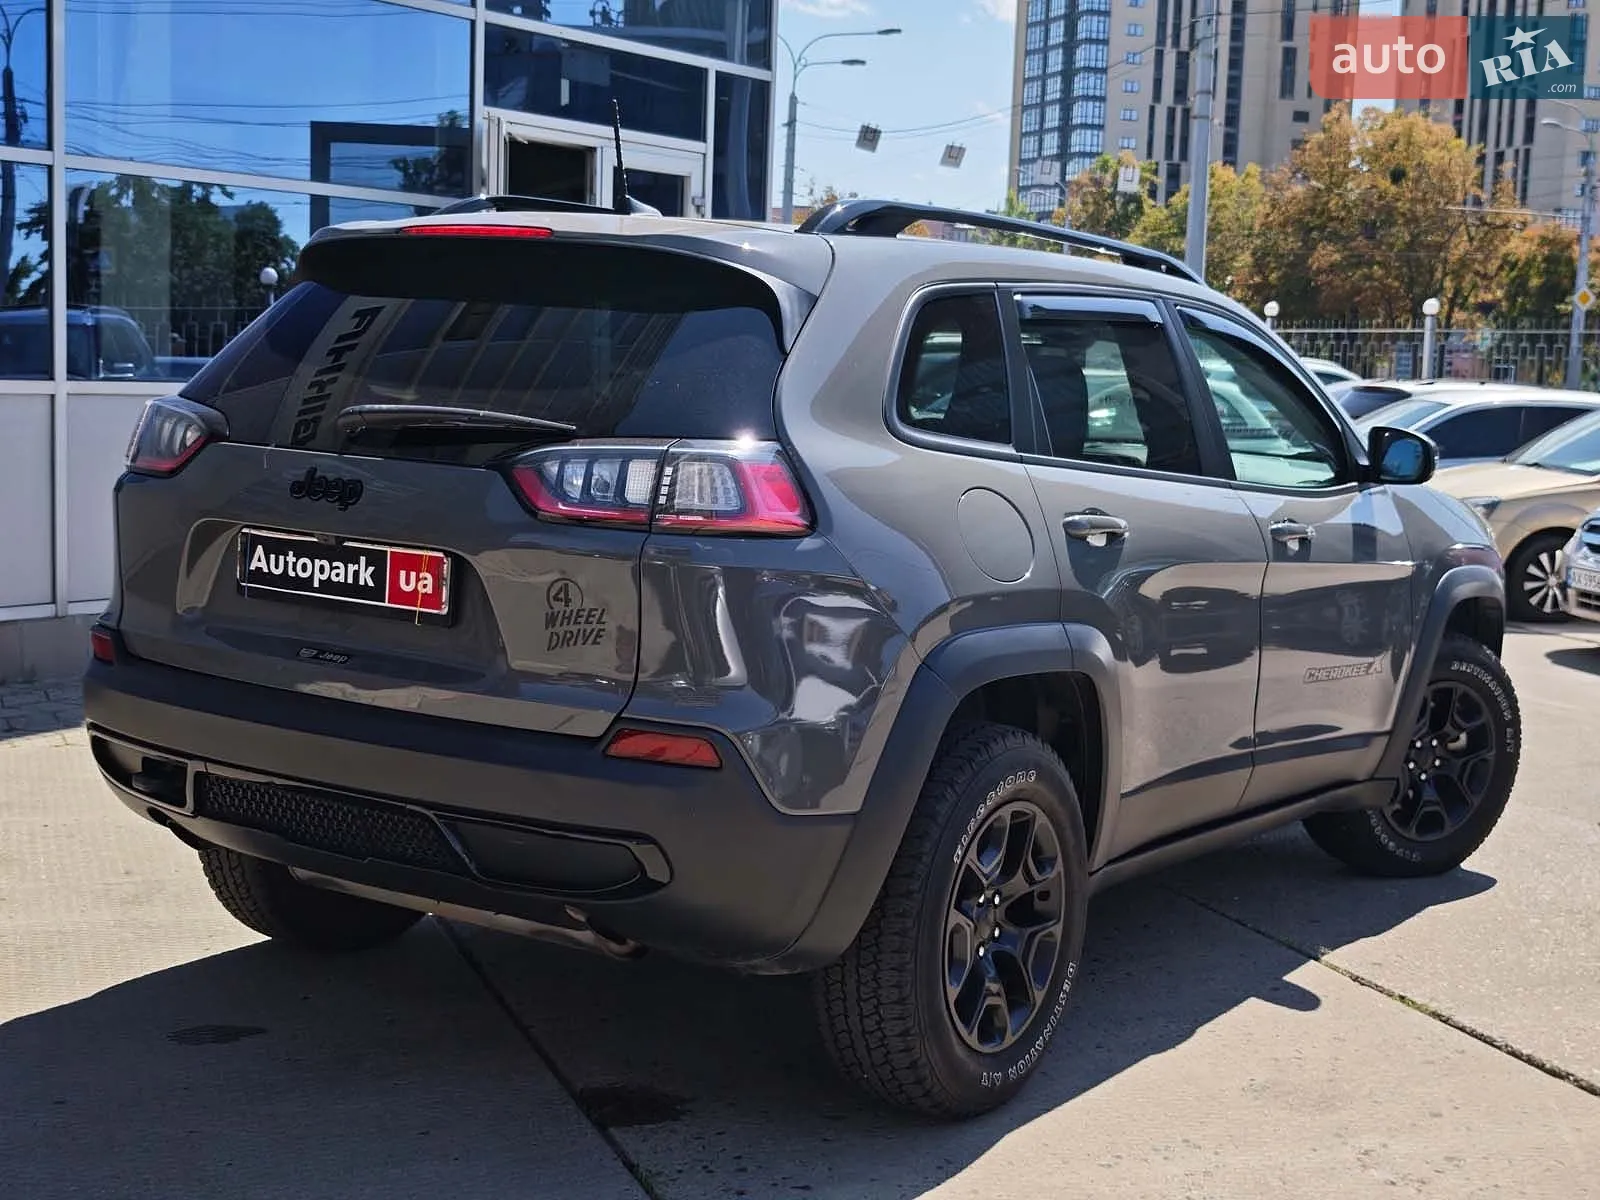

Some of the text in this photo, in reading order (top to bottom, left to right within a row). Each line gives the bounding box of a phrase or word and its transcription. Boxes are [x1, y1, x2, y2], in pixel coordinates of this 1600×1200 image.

[289, 466, 364, 511] Jeep
[249, 544, 433, 594] Autopark ua
[552, 582, 572, 608] 4
[544, 608, 607, 630] WHEEL
[547, 628, 606, 652] DRIVE
[953, 769, 1037, 864] Firestone
[981, 961, 1077, 1088] DESTINATION A/T
